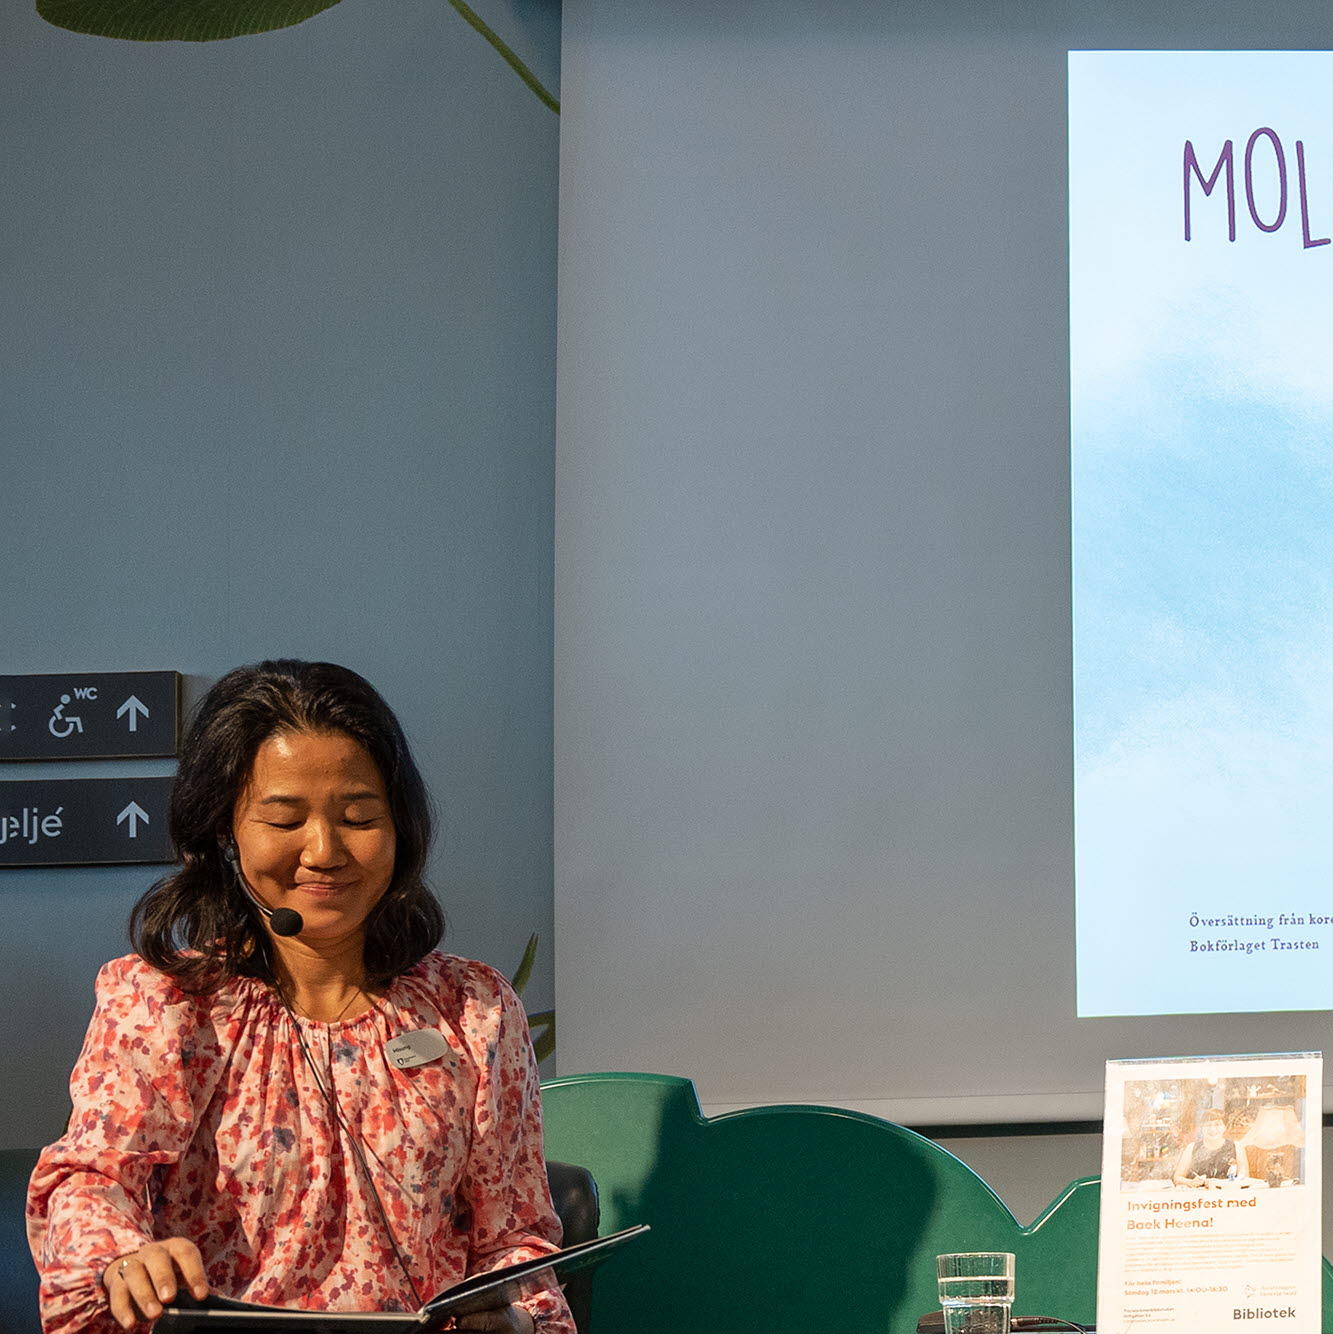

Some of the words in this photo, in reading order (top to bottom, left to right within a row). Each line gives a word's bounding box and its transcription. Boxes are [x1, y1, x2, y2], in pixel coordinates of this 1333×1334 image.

[73, 687, 98, 700] WC
[1189, 912, 1274, 929] Översättning
[1278, 913, 1305, 926] från
[1190, 939, 1266, 954] Bokförlaget
[1270, 938, 1319, 950] Trasten
[1127, 1198, 1224, 1213] Invigningsfest
[1227, 1197, 1257, 1209] med
[1127, 1218, 1161, 1230] Baek
[1164, 1217, 1214, 1230] Heena!
[1233, 1306, 1296, 1320] Bibliotek
